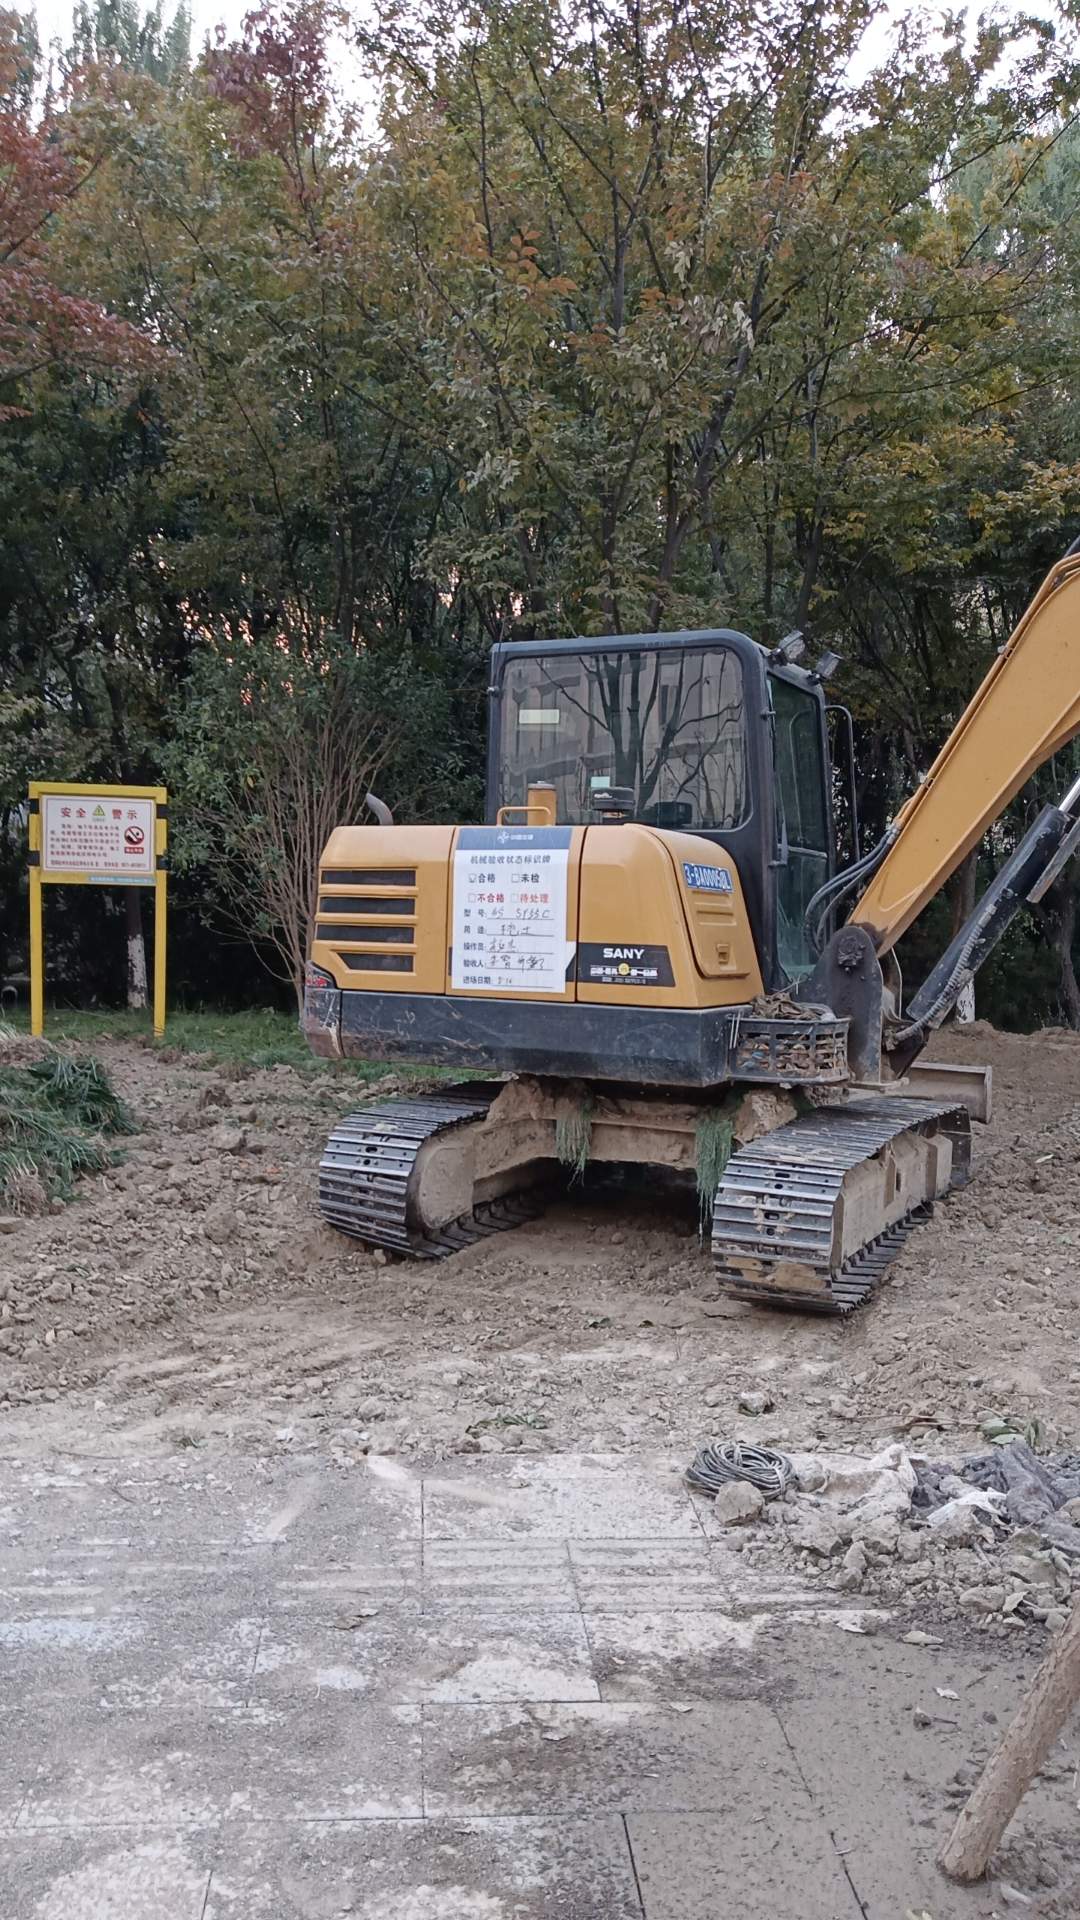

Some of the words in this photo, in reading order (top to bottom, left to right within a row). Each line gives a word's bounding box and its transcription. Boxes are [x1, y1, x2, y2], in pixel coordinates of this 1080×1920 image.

[61, 807, 86, 818] 安全
[470, 855, 551, 865] 机械验收状态标识牌
[478, 873, 496, 883] 合格
[521, 873, 540, 883] 未检
[477, 893, 504, 903] 不合格
[520, 893, 550, 903] 待处理
[603, 947, 645, 959] SANY
